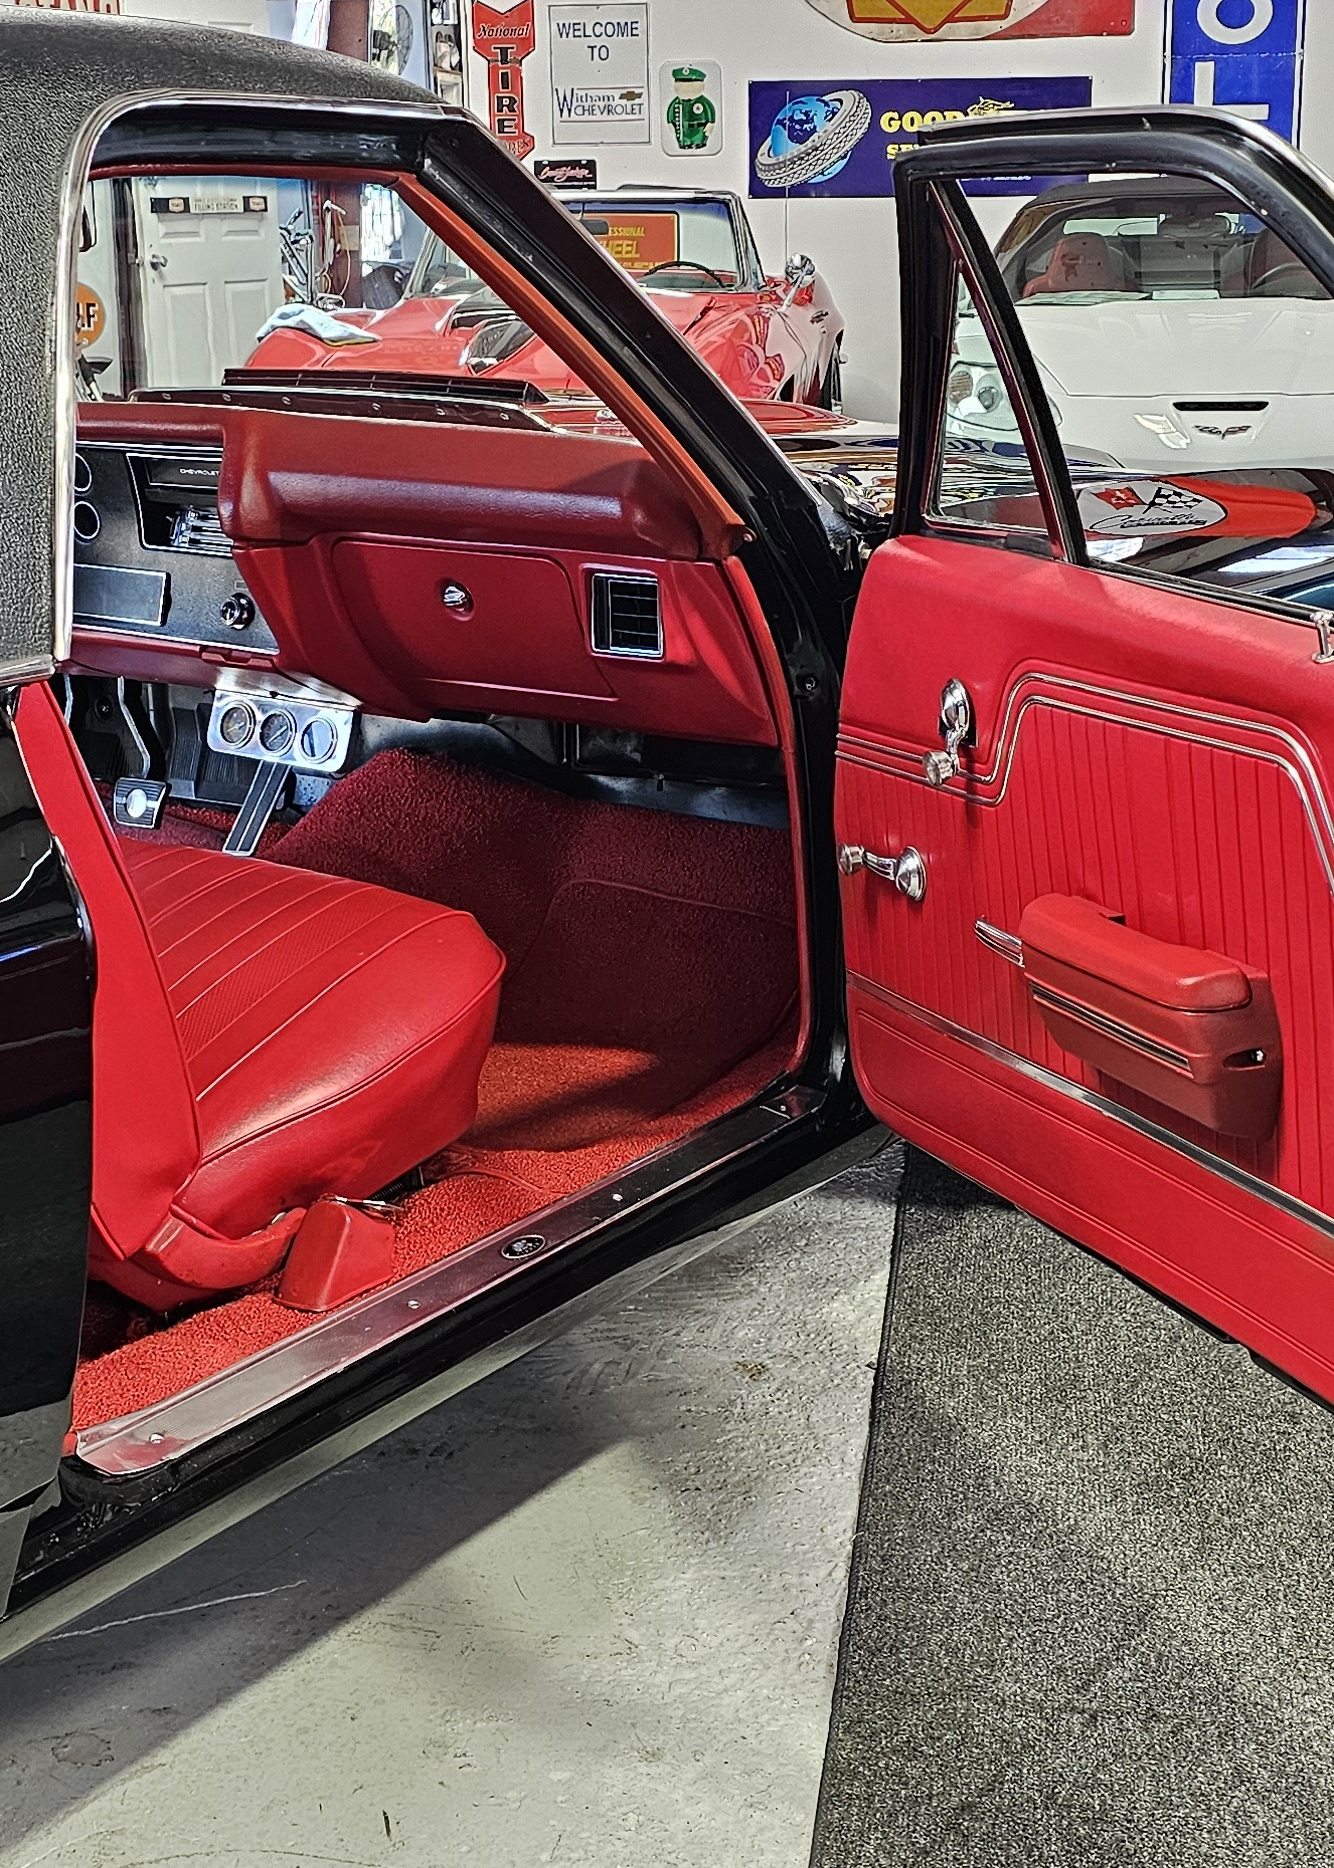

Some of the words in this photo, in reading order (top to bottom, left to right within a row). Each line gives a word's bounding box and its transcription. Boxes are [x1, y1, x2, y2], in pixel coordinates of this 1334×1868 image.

[478, 22, 530, 38] National
[556, 21, 640, 38] WELCOME
[587, 44, 610, 61] TO
[492, 45, 519, 135] TIRE
[555, 87, 615, 118] Witham
[574, 103, 644, 116] CHEVROLET
[179, 468, 220, 476] CHEVROLET
